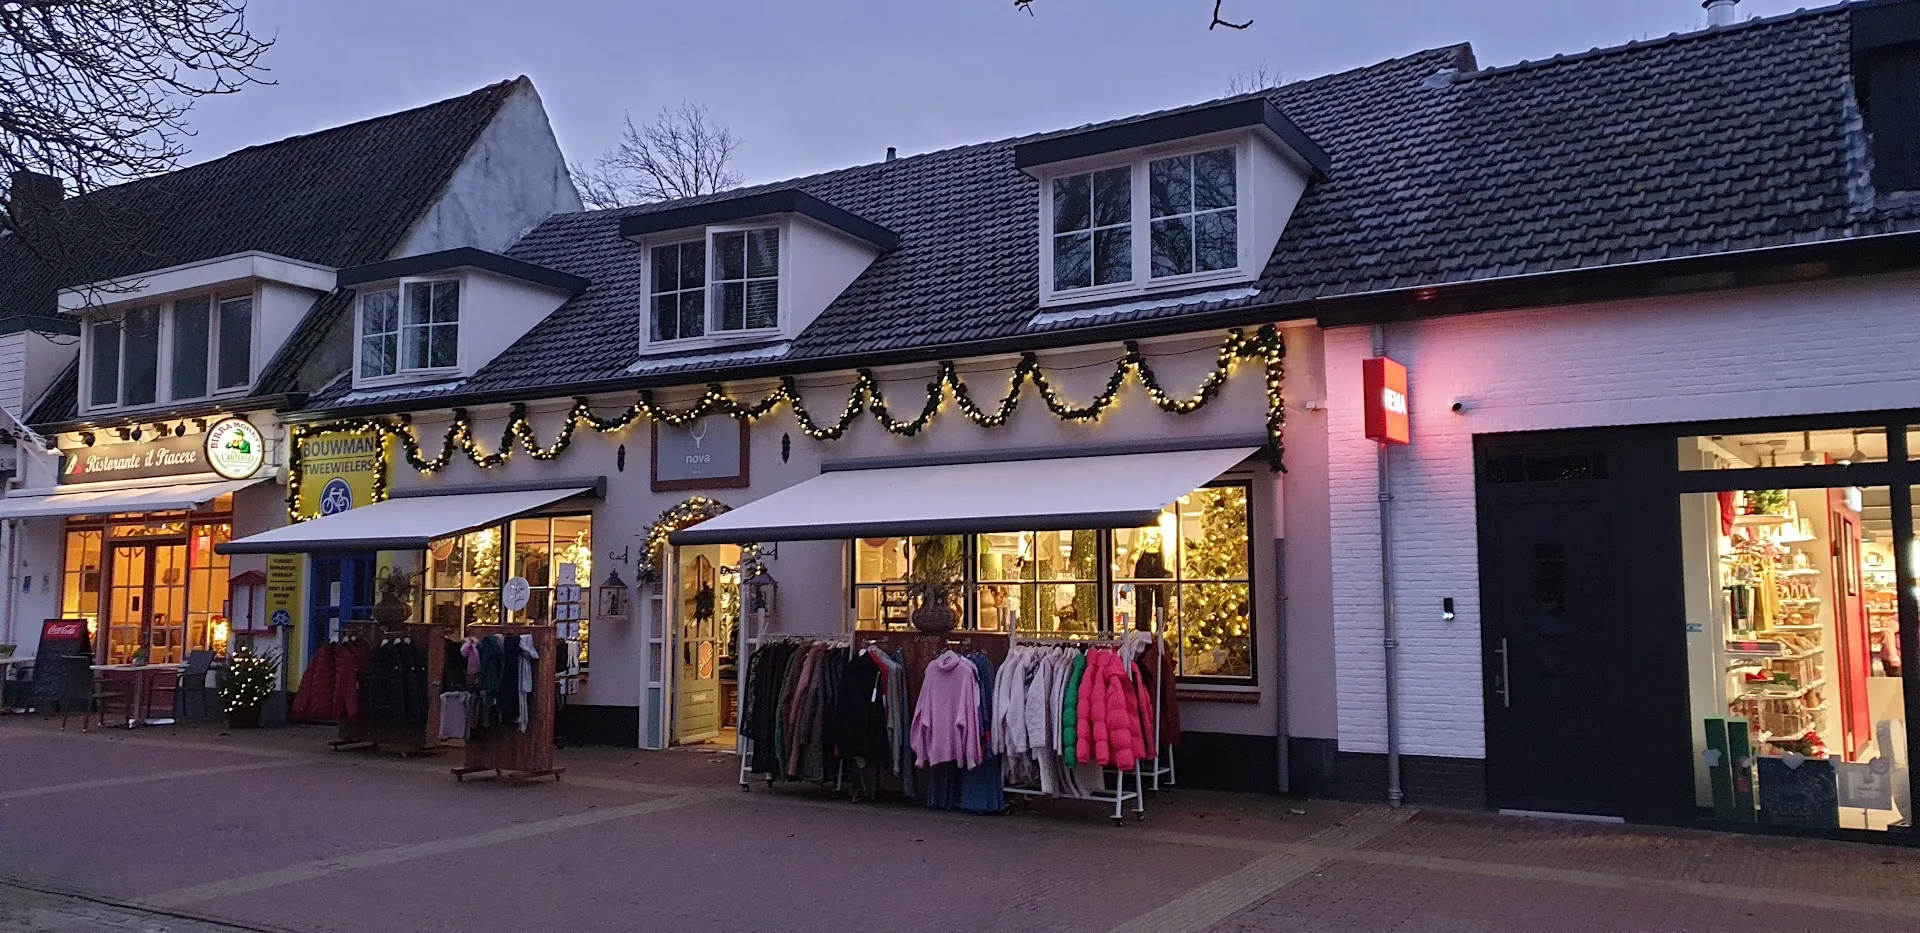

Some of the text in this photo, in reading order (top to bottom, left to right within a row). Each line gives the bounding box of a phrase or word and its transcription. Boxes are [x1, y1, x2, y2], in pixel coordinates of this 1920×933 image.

[210, 423, 232, 449] BIRRA
[303, 436, 374, 458] BOUWMAN
[85, 447, 197, 473] Ristorante il Piacere
[303, 459, 374, 475] TWEEWIELERS
[685, 453, 711, 464] nova
[47, 624, 78, 635] Coca-Cola
